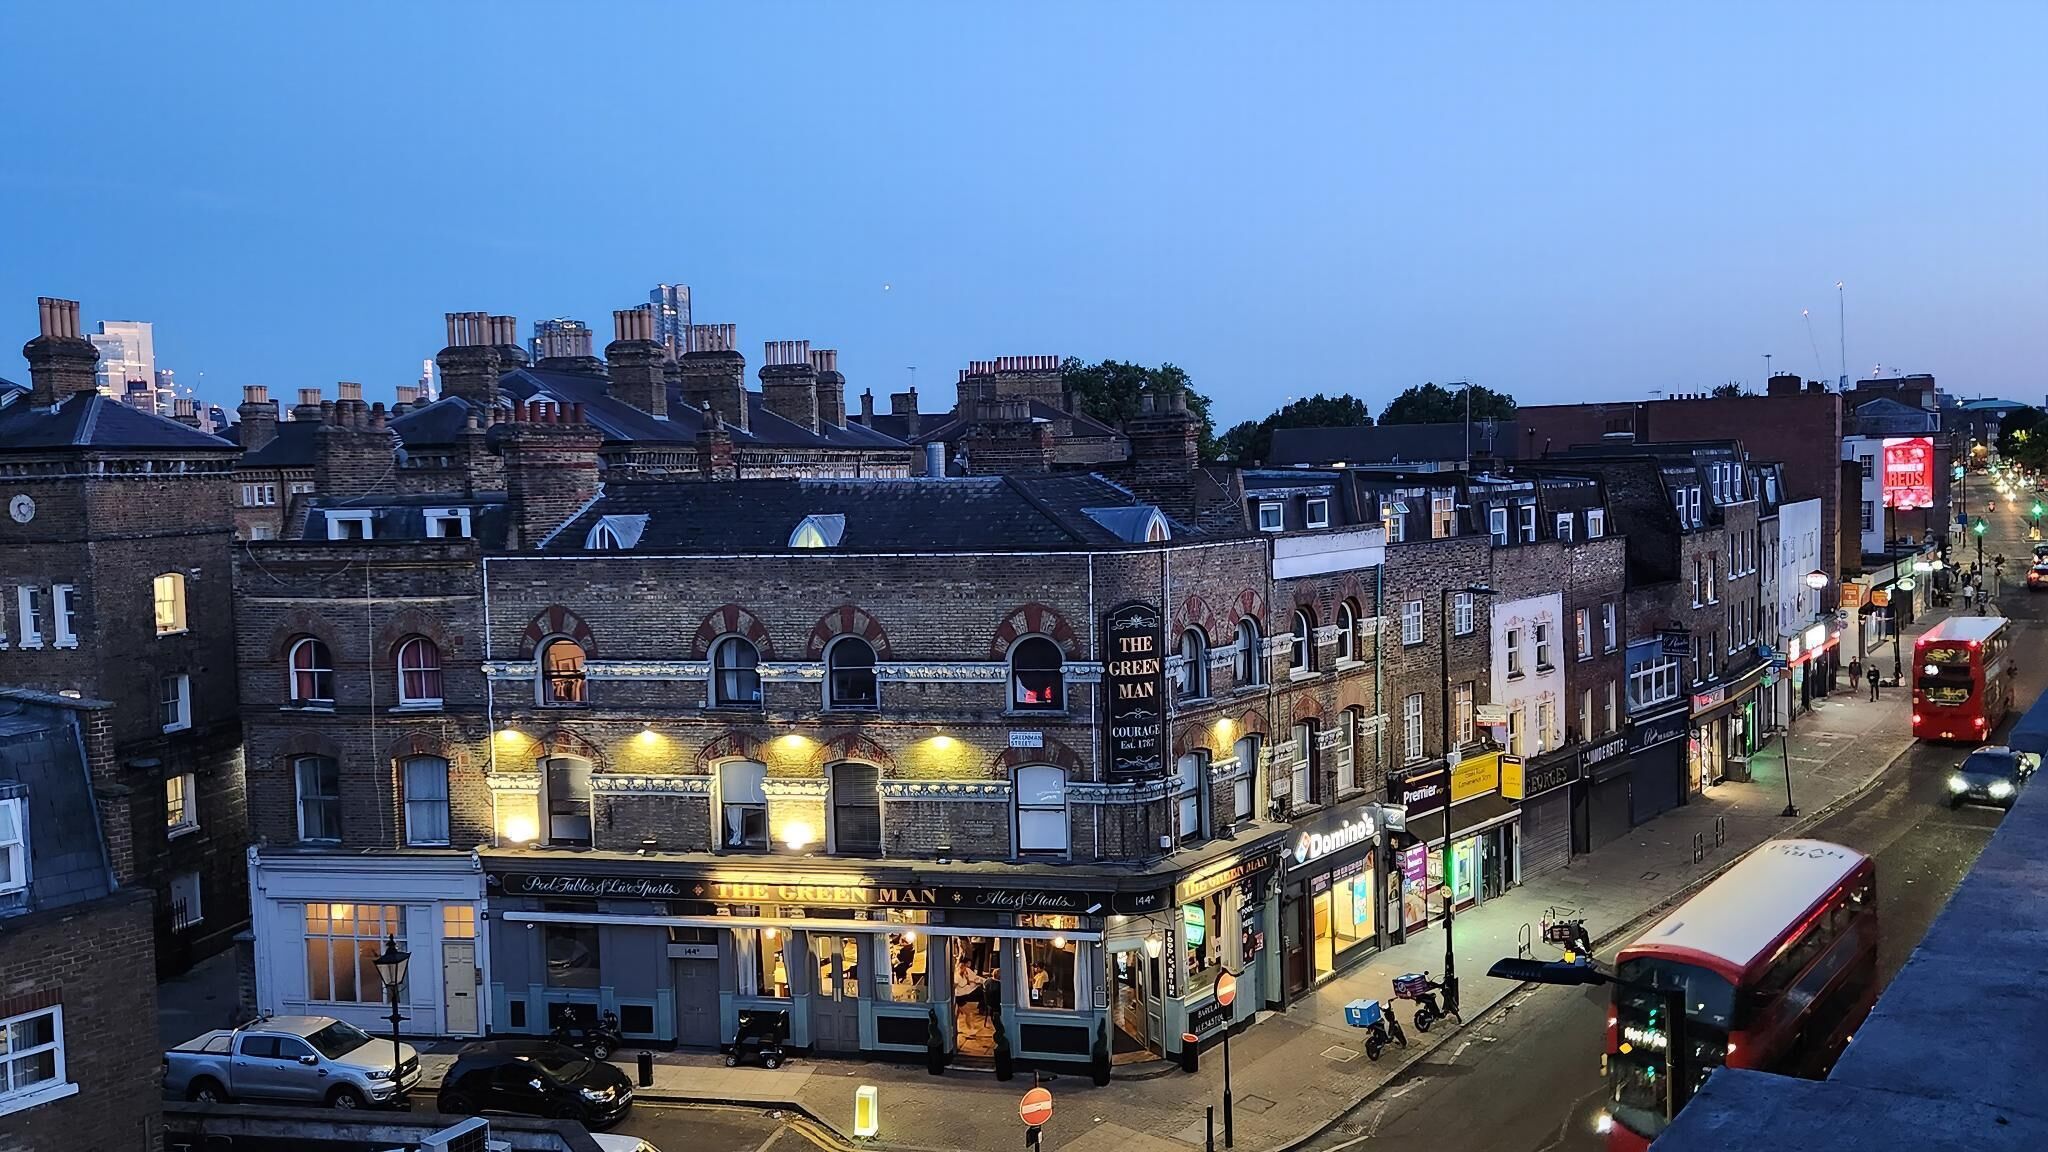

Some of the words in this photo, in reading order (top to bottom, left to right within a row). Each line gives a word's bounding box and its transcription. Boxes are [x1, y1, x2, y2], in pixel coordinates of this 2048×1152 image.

[1119, 636, 1153, 653] THE
[1108, 657, 1161, 677] GREEN
[1118, 681, 1155, 700] MAN
[1112, 723, 1161, 738] COURAGE
[1120, 740, 1136, 750] Est.
[1138, 737, 1155, 748] 1787
[1526, 766, 1568, 795] GEORGES
[1403, 784, 1437, 805] Premier
[1309, 812, 1375, 859] Domino's
[1246, 856, 1268, 873] MAN
[522, 875, 556, 891] Pool
[555, 877, 595, 893] Tables
[632, 879, 681, 897] Sports
[714, 883, 768, 899] THE
[778, 885, 867, 903] GREEN
[877, 888, 936, 904] MAN
[976, 890, 1014, 906] Ales
[1024, 892, 1076, 907] Stouts
